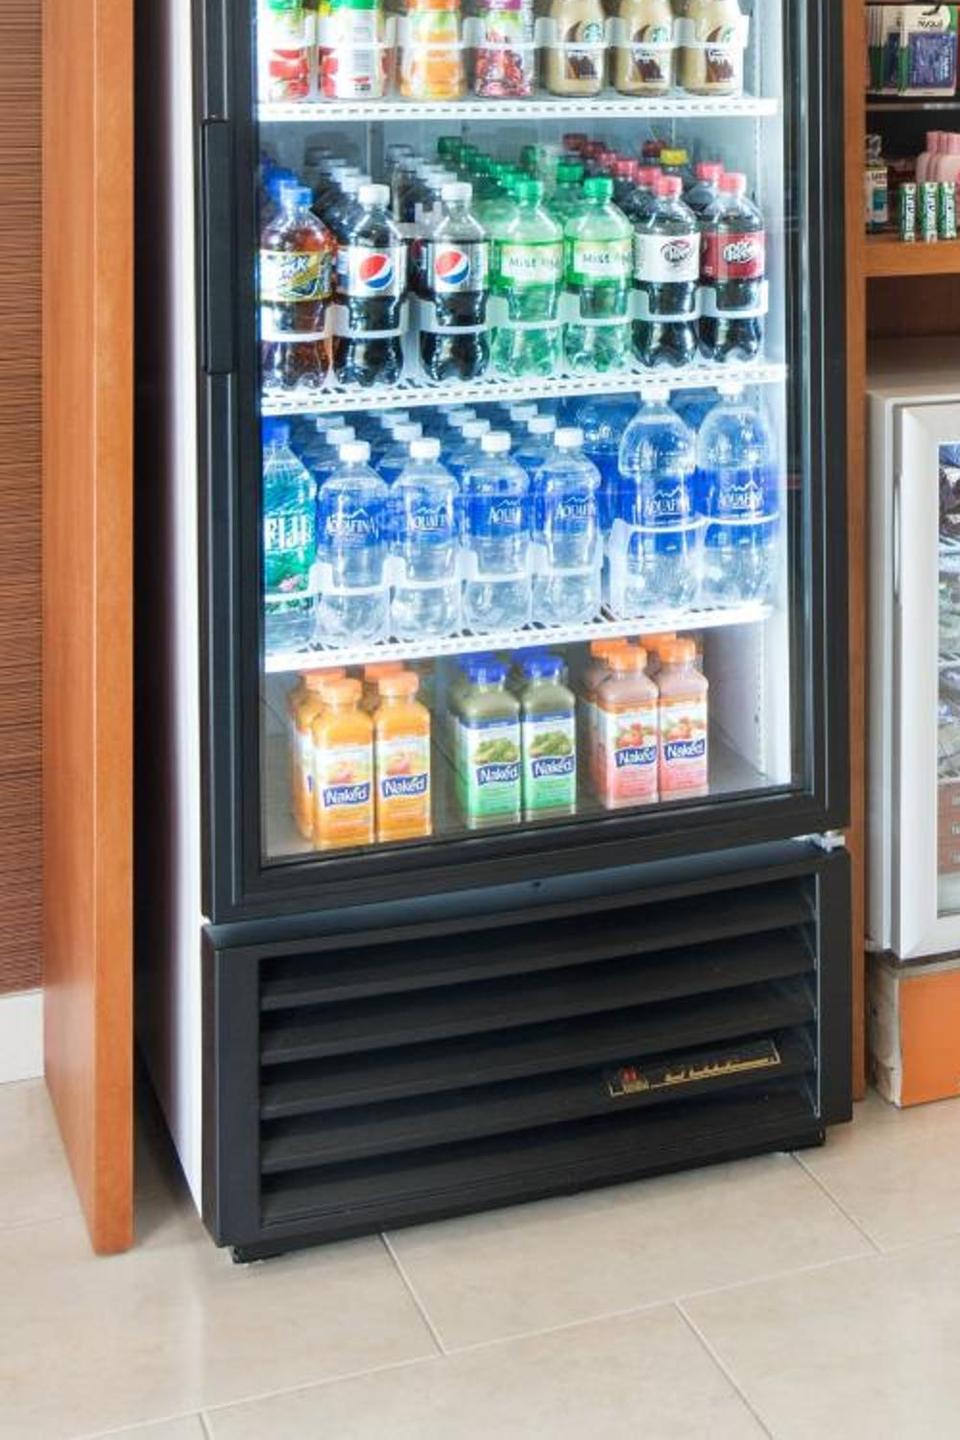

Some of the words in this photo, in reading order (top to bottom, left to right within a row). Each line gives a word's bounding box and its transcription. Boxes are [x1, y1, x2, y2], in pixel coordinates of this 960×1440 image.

[618, 747, 656, 765] Naked
[666, 740, 704, 758] Naked
[479, 765, 519, 784] Naked
[533, 758, 573, 777] Naked
[326, 785, 369, 805] Naked
[383, 776, 426, 796] Naked
